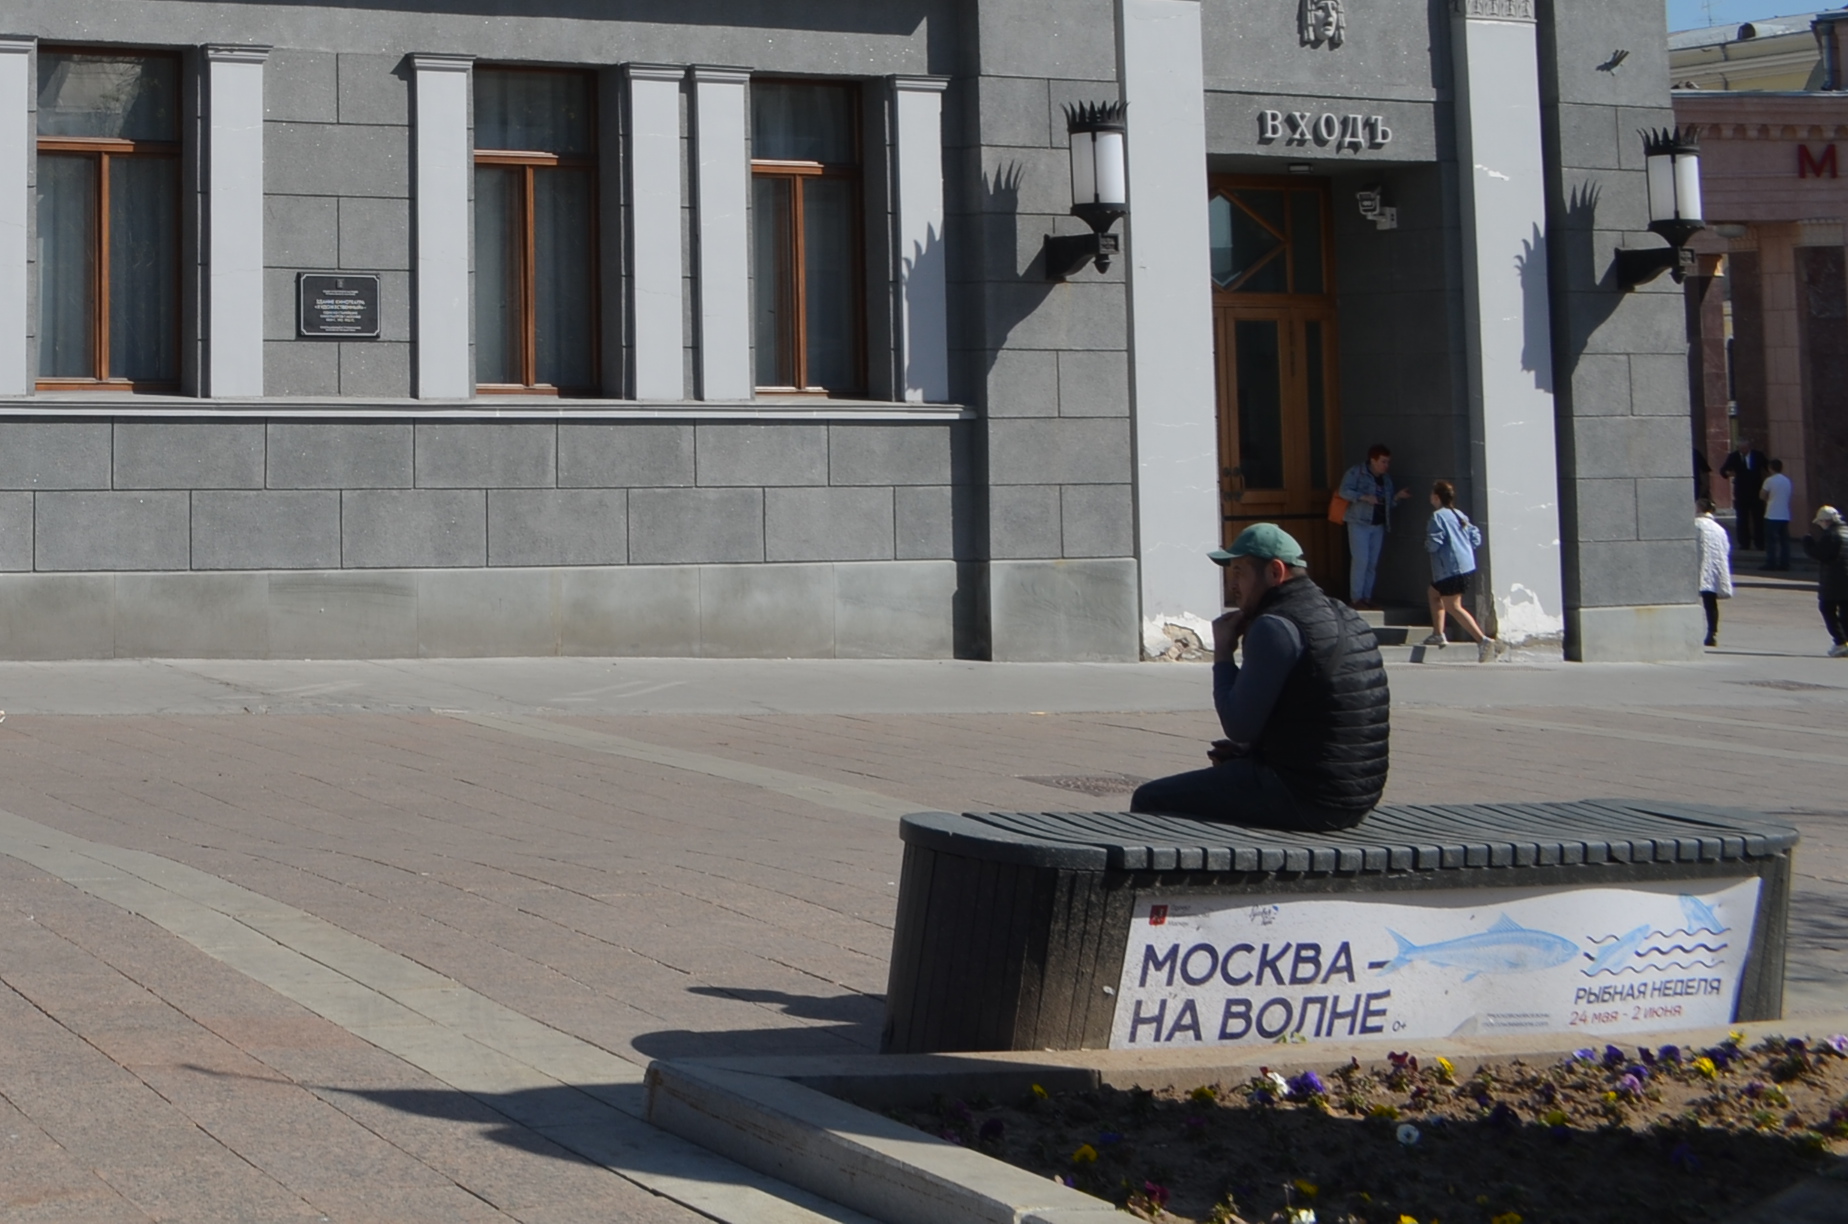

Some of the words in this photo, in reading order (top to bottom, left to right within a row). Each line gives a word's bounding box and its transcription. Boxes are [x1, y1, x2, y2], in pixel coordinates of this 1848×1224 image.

[1262, 108, 1394, 149] ВХОДЪ
[1138, 940, 1357, 988] МОСКВА
[1573, 981, 1648, 1005] РЫБНАЯ
[1650, 977, 1722, 999] НЕДЕЛЯ
[1127, 997, 1203, 1043] НА
[1217, 988, 1392, 1042] ВОЛНЕ
[1568, 1010, 1588, 1026] 24
[1590, 1010, 1619, 1024] мая
[1631, 1005, 1642, 1021] 2
[1643, 1005, 1683, 1019] июня
